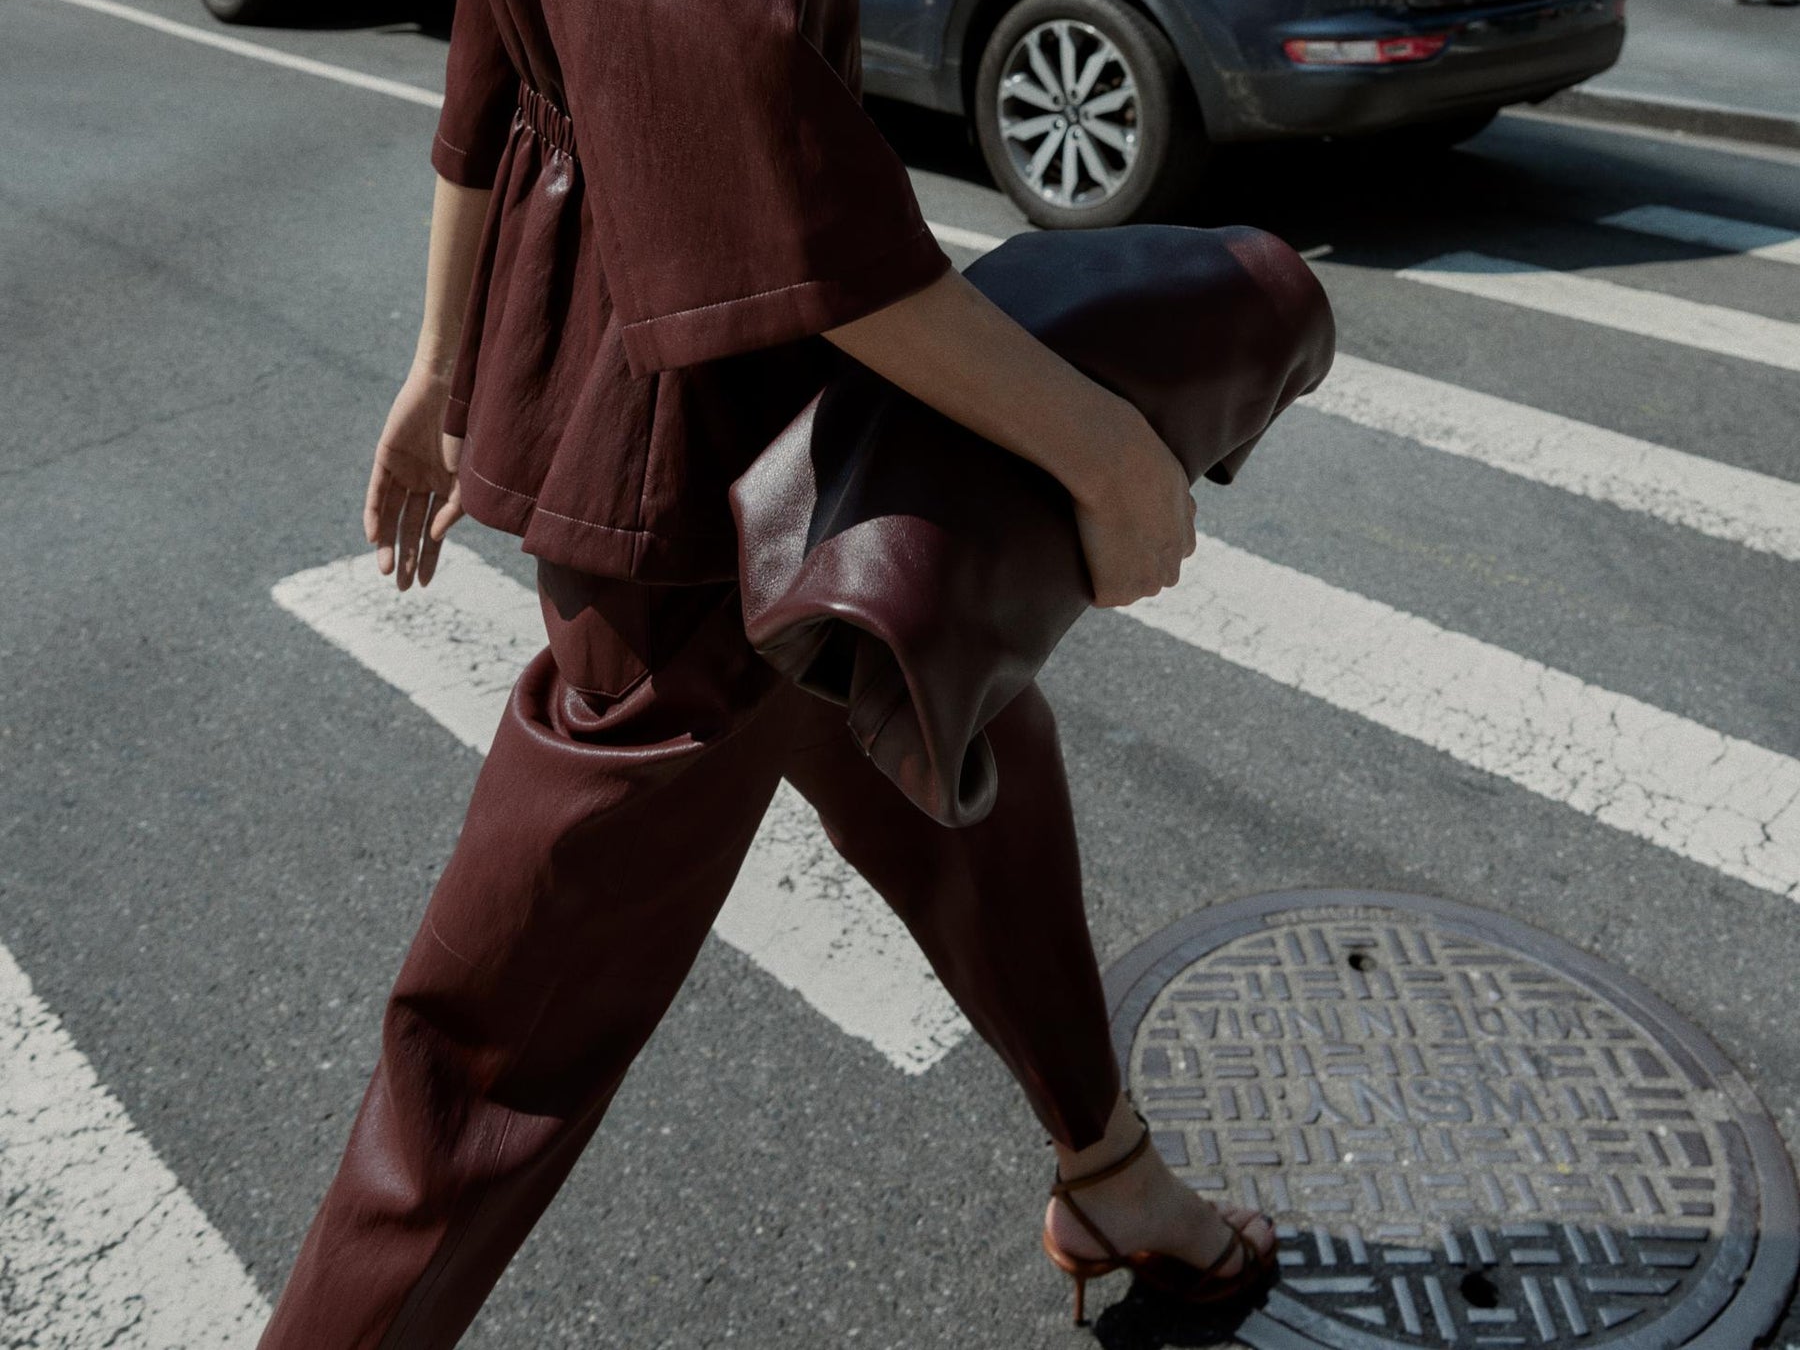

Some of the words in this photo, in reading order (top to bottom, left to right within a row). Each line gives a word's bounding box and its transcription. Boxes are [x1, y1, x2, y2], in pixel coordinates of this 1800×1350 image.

[1186, 1004, 1345, 1041] INDIA
[1357, 1004, 1418, 1040] IN
[1423, 1003, 1593, 1041] MADE
